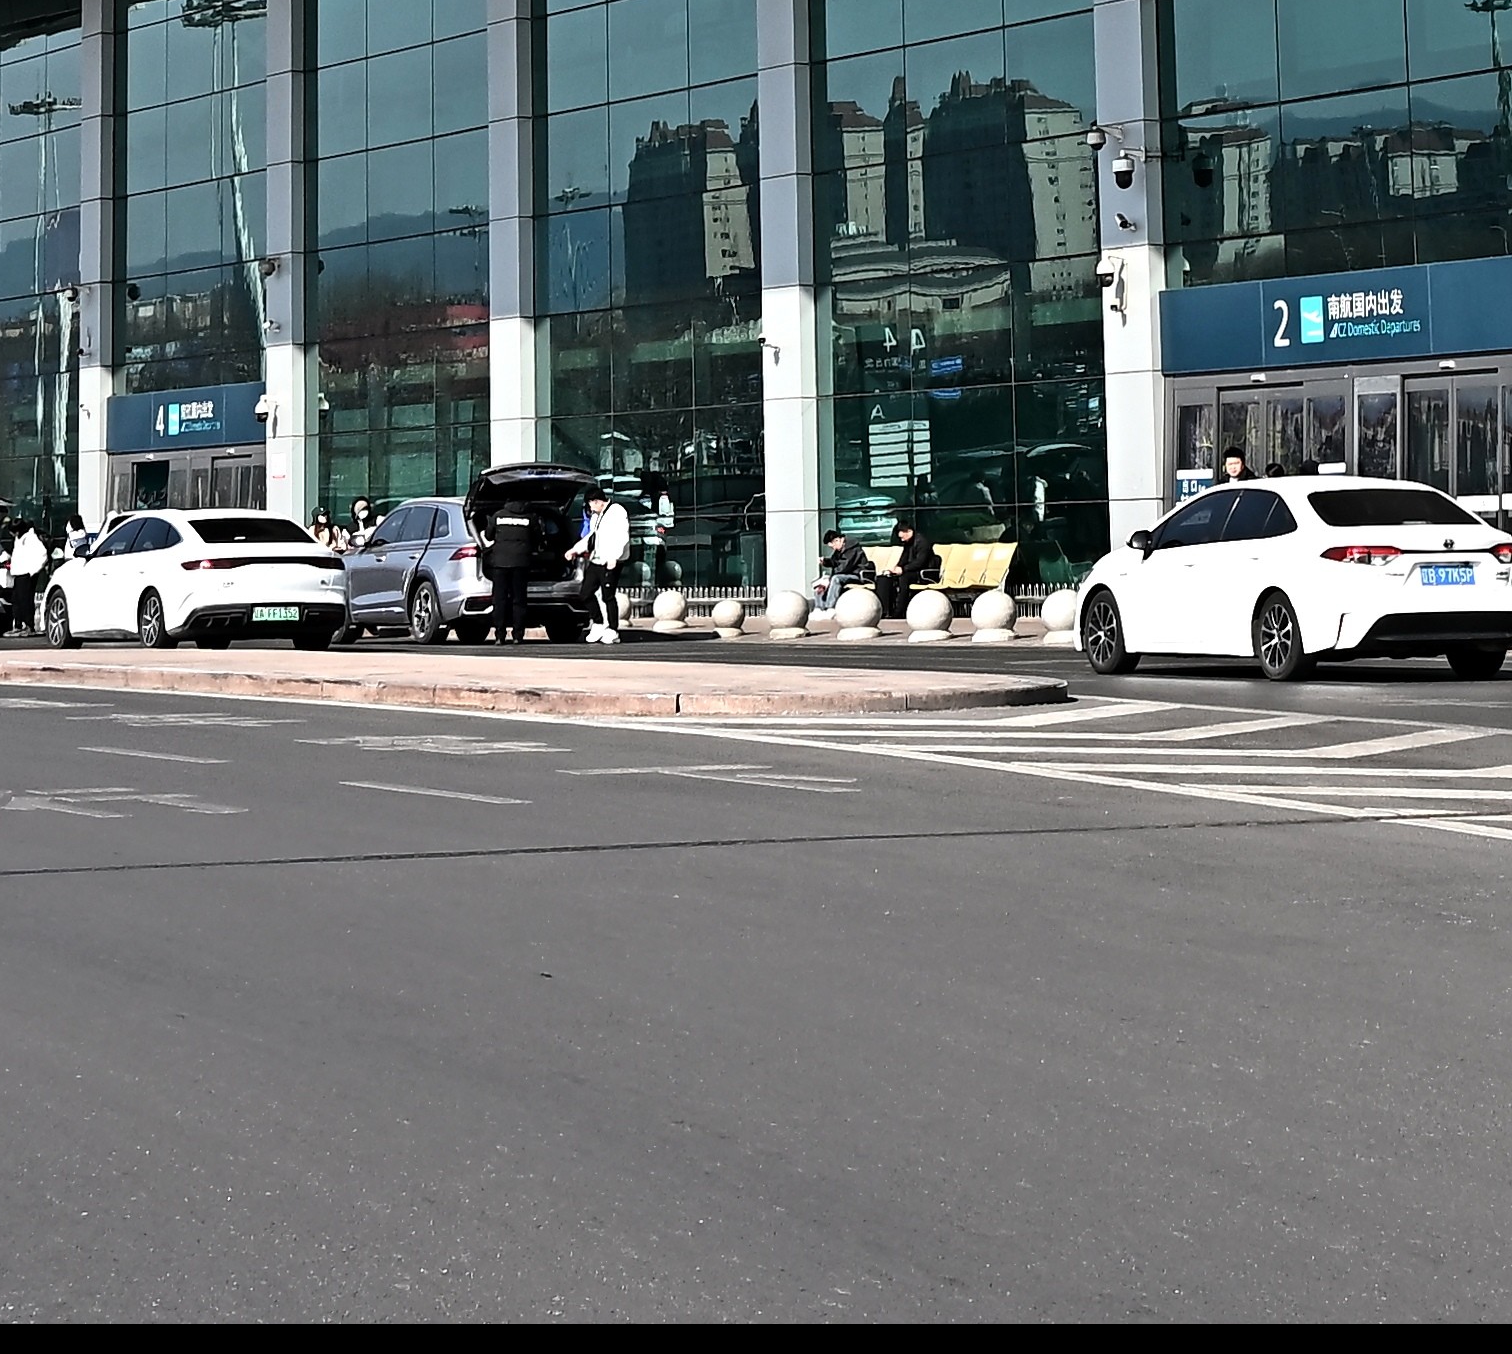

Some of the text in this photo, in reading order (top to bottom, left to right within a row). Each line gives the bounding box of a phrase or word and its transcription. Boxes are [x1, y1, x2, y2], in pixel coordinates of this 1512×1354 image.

[1326, 288, 1403, 320] 南航国内出发
[1273, 299, 1290, 347] 2
[1347, 319, 1380, 337] Domestic
[1381, 319, 1421, 338] Departures
[155, 405, 164, 437] 4
